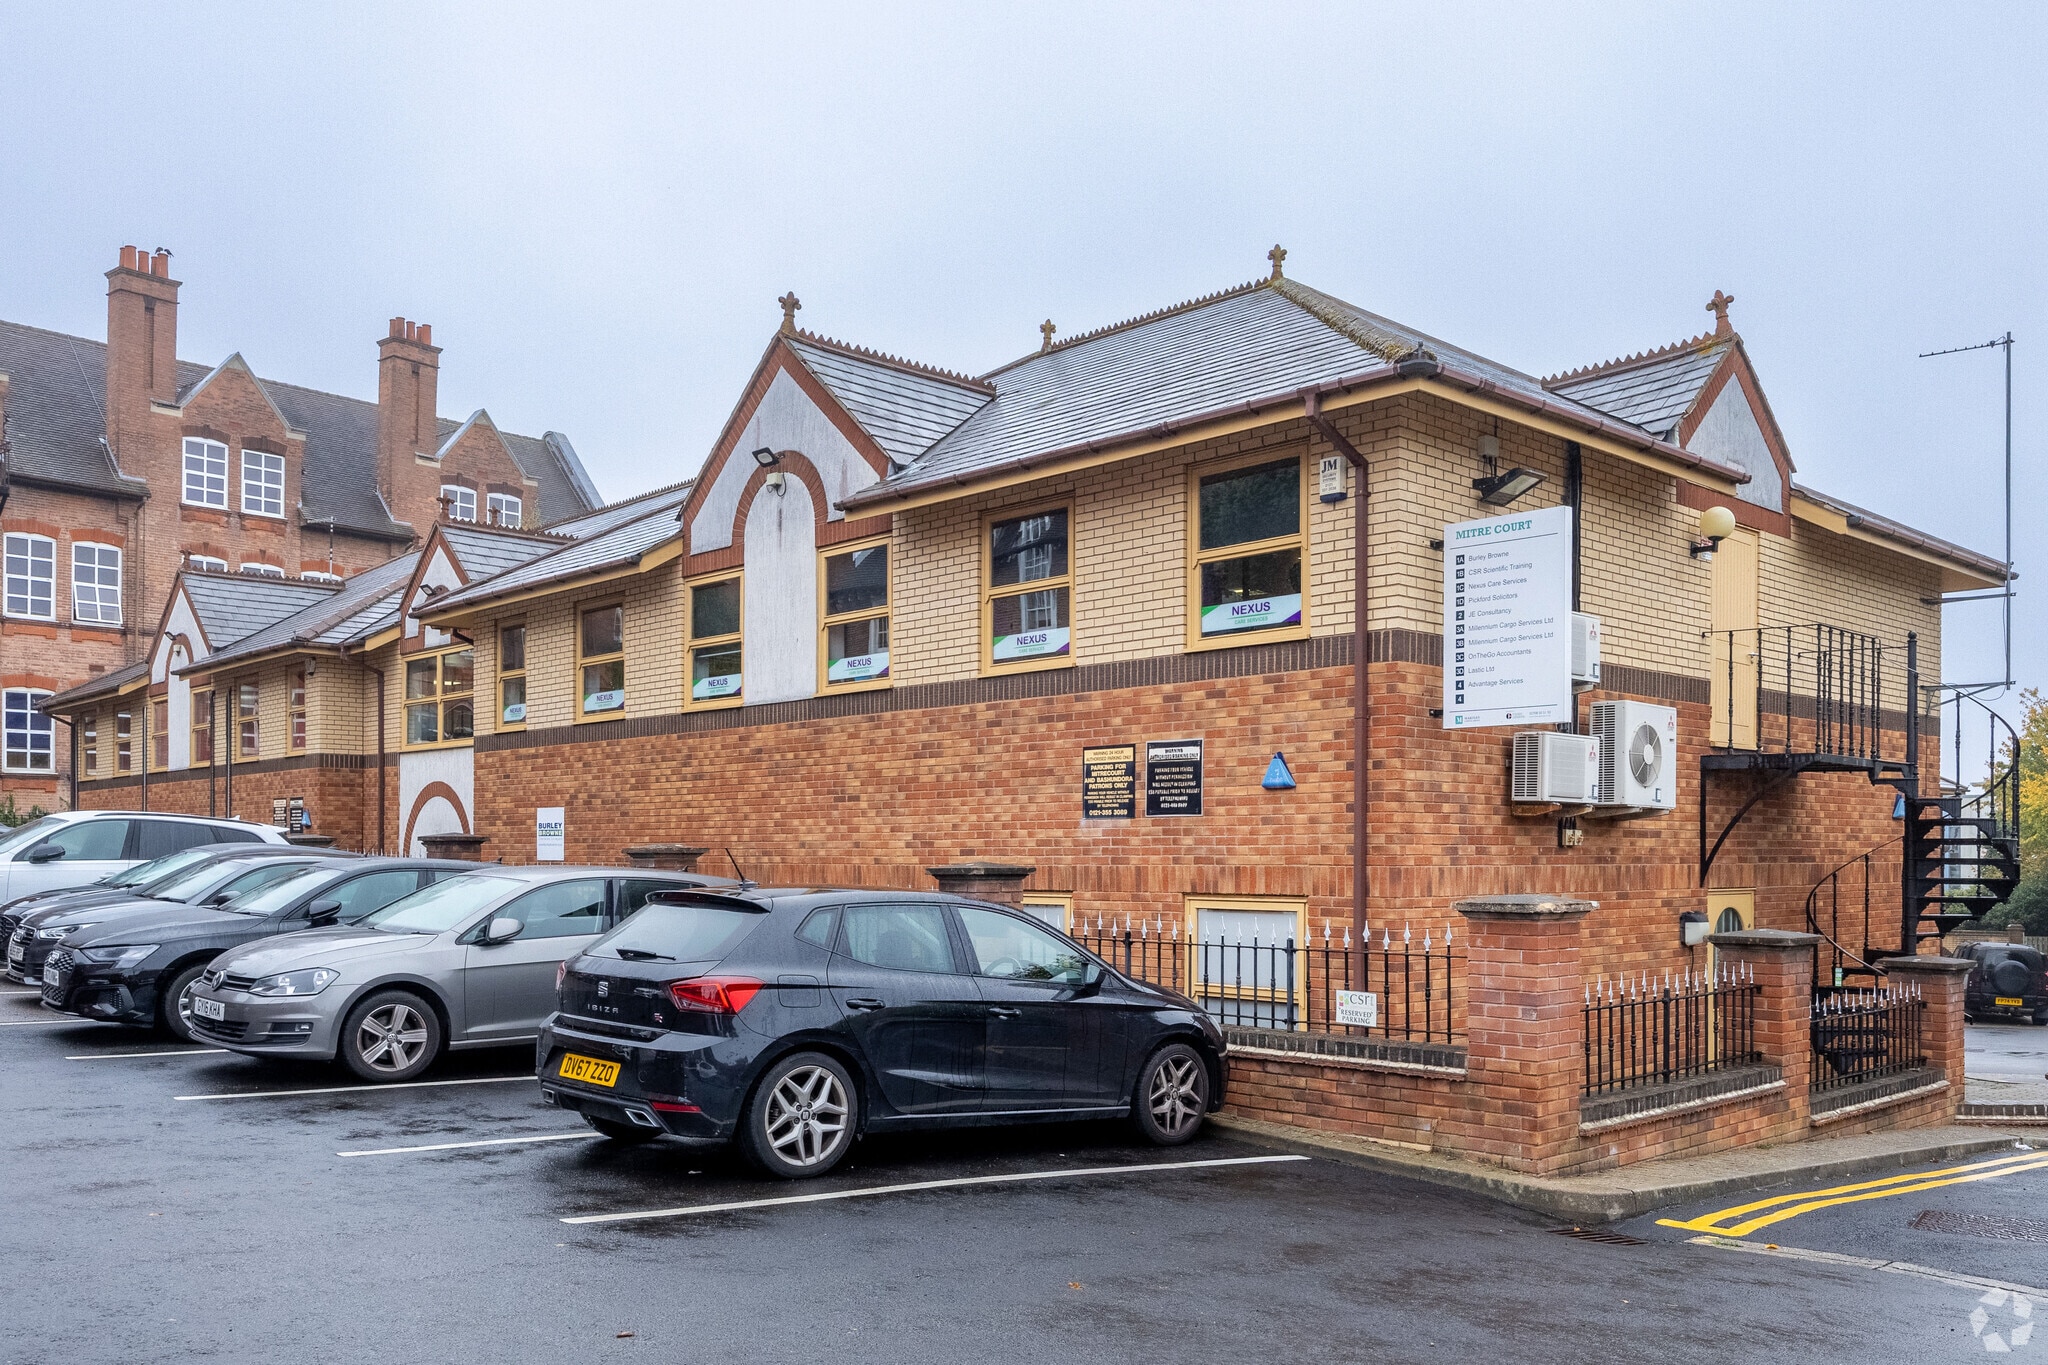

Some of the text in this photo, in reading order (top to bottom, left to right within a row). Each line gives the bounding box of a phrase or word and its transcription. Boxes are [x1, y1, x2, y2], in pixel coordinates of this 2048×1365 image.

[1322, 459, 1337, 473] JM
[1456, 520, 1532, 539] MITRE COURT
[1483, 565, 1508, 574] Scientific
[1502, 577, 1527, 586] Services
[1232, 602, 1270, 616] NEXUS
[1477, 608, 1511, 616] Consultancy
[1017, 634, 1047, 645] NEXUS
[847, 658, 871, 668] NEXUS
[708, 678, 728, 687] NEXUS
[210, 1002, 220, 1017] KHA
[588, 1004, 619, 1014] IBIZA
[1342, 1016, 1370, 1024] PARKING
[564, 1057, 614, 1082] DV67 ZZO
